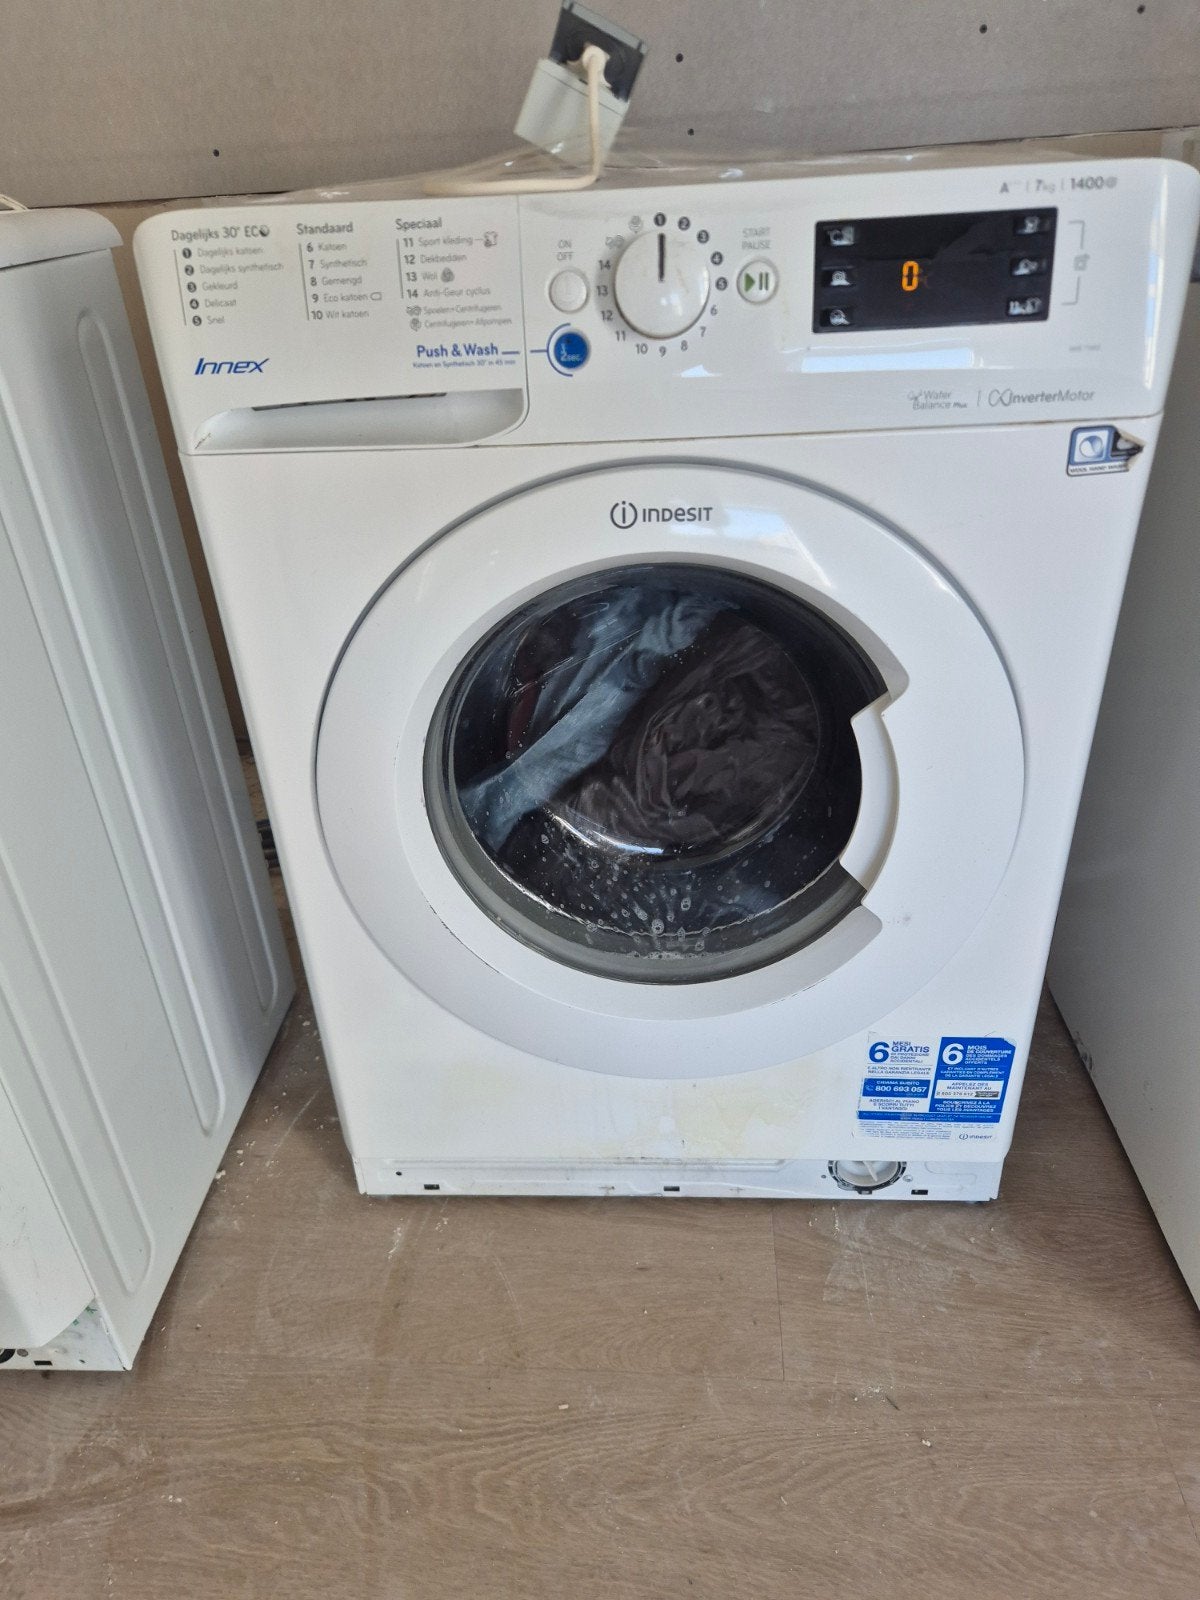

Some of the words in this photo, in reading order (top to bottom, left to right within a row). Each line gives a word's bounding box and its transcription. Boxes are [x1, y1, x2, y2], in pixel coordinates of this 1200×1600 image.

[1070, 175, 1104, 190] 1400
[395, 217, 442, 232] Speciaal
[654, 212, 667, 227] 1
[678, 216, 691, 231] 2
[296, 221, 353, 236] Standaard
[742, 227, 771, 238] START
[171, 229, 219, 243] Dagelijks
[697, 229, 709, 244] 3
[307, 242, 314, 253] 6
[318, 242, 347, 252] Katoen
[403, 238, 414, 248] 11
[558, 239, 571, 249] ON
[742, 239, 771, 250] PAUSE
[197, 247, 233, 259] Dagelijks
[710, 251, 723, 266] 4
[308, 259, 315, 270] 7
[320, 258, 368, 270] Synthetisch
[404, 254, 416, 265] 12
[598, 259, 611, 270] 14
[199, 264, 236, 276] Dagelijks
[901, 260, 919, 291] 0
[310, 275, 318, 287] 8
[322, 274, 363, 286] Gemengd
[406, 271, 418, 282] 13
[202, 280, 239, 292] Gekleurd
[715, 277, 728, 292] 5
[407, 289, 419, 299] 14
[466, 286, 491, 298] cyclus
[596, 285, 608, 297] 13
[204, 298, 237, 308] Delicaat
[312, 292, 319, 304] 9
[340, 292, 369, 301] katoen
[310, 309, 324, 321] 10
[341, 309, 369, 319] katoen
[601, 310, 613, 322] 12
[710, 305, 718, 316] 6
[206, 315, 226, 326] Snel
[615, 331, 626, 342] 11
[700, 326, 707, 337] 7
[416, 344, 449, 359] Push
[451, 344, 463, 357] &
[463, 342, 499, 356] Wash
[635, 343, 649, 355] 10
[680, 340, 689, 351] 8
[659, 346, 667, 358] 9
[194, 357, 270, 376] Innex
[923, 390, 951, 400] Water
[912, 401, 951, 411] Balance
[642, 507, 713, 523] INDESIT
[869, 1041, 890, 1063] 6
[942, 1043, 964, 1065] 6
